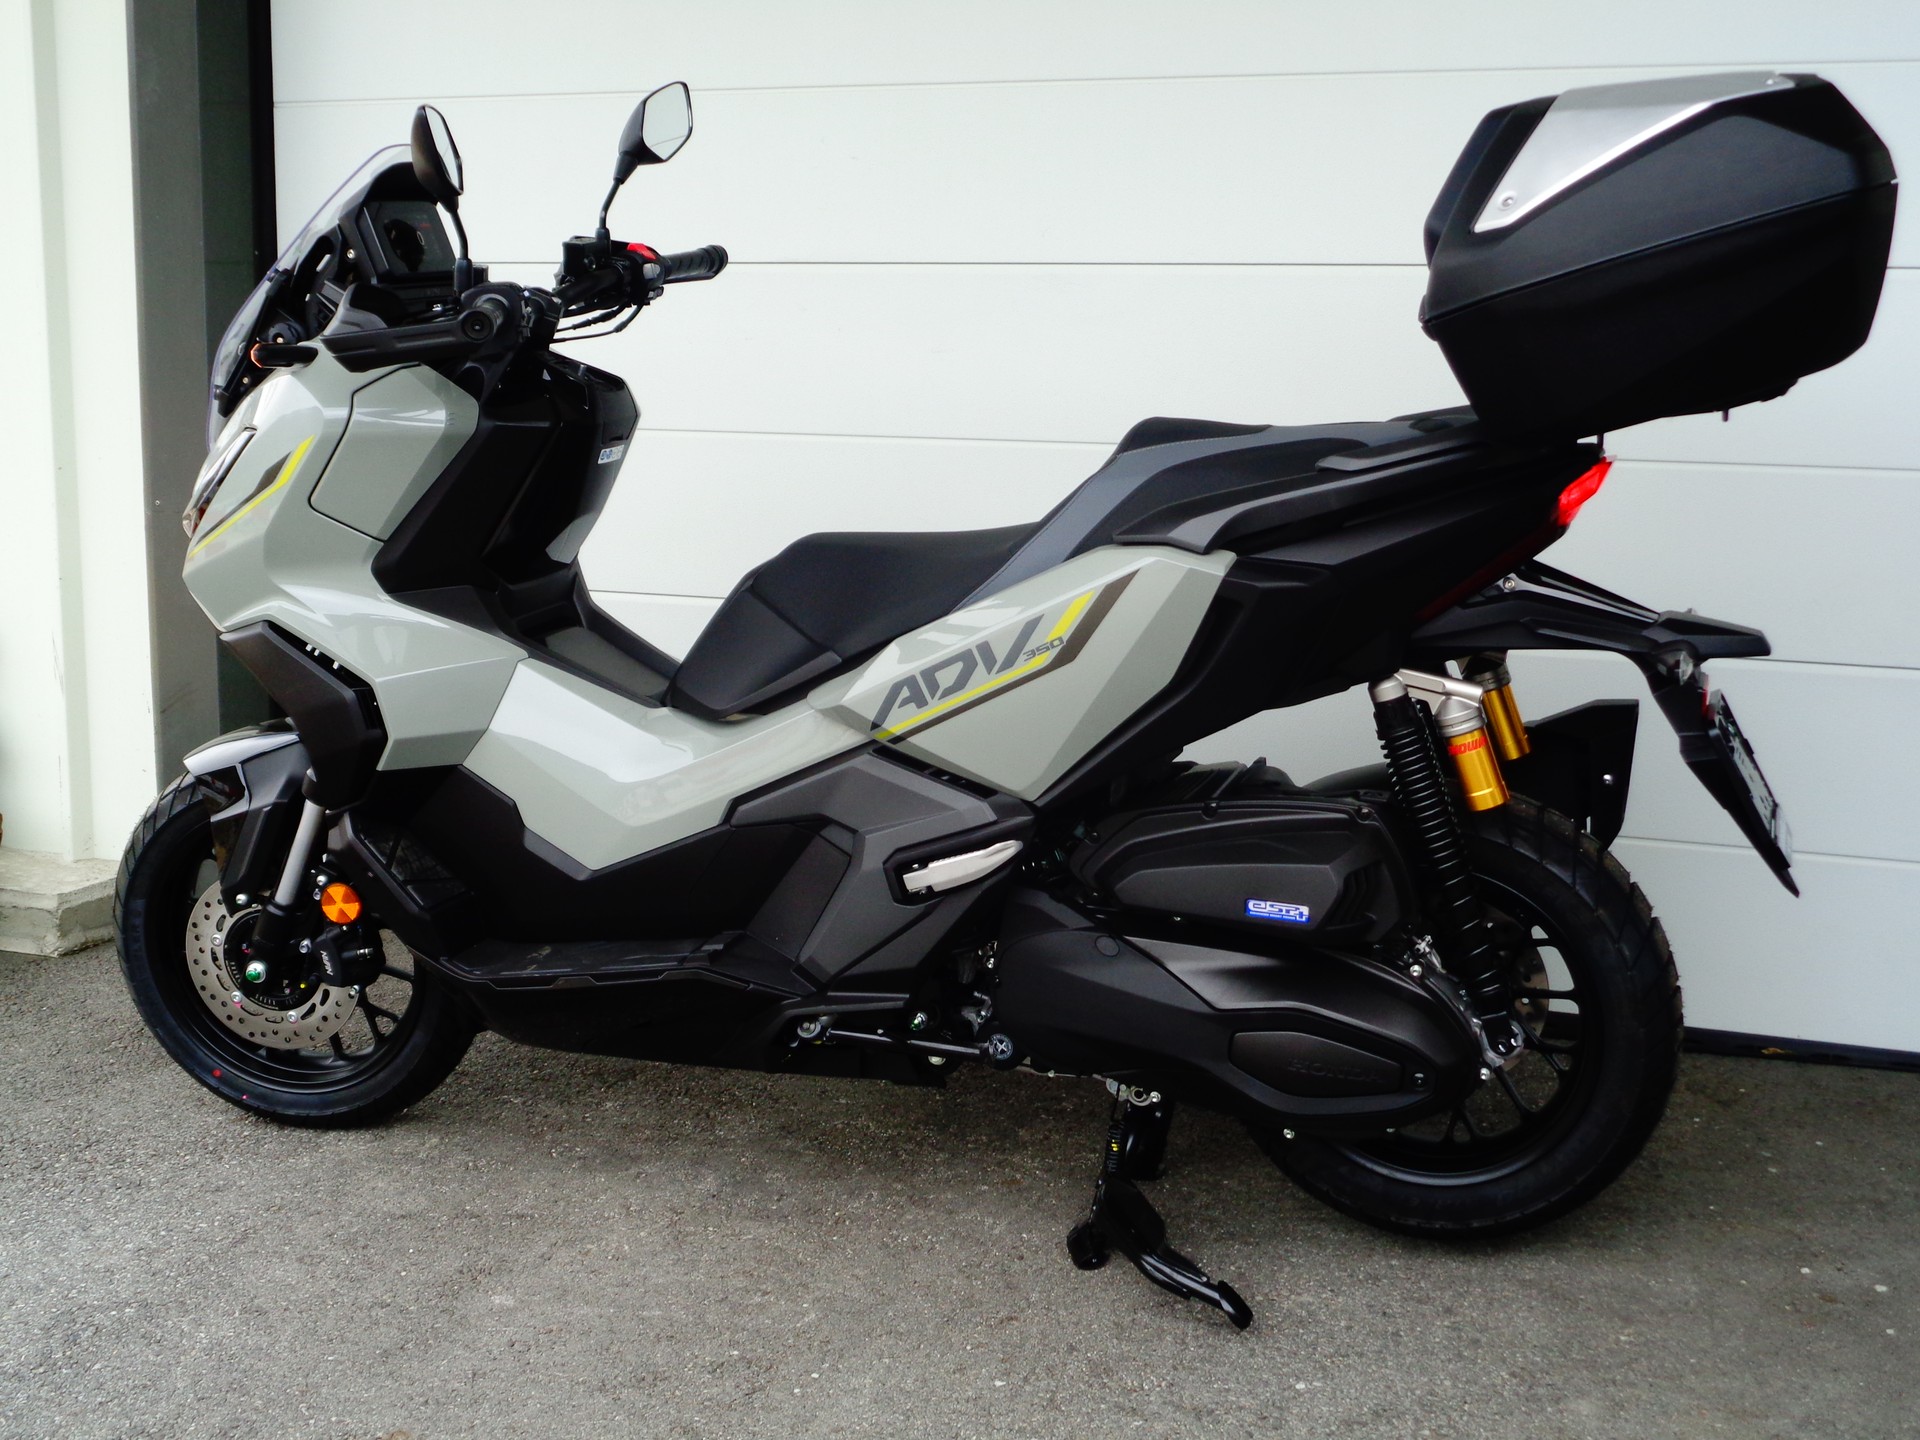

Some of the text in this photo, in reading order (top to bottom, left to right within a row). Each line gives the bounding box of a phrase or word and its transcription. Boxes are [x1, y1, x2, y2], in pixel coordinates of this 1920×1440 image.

[870, 613, 1065, 732] ADV 350
[1287, 1057, 1385, 1083] HONDA
